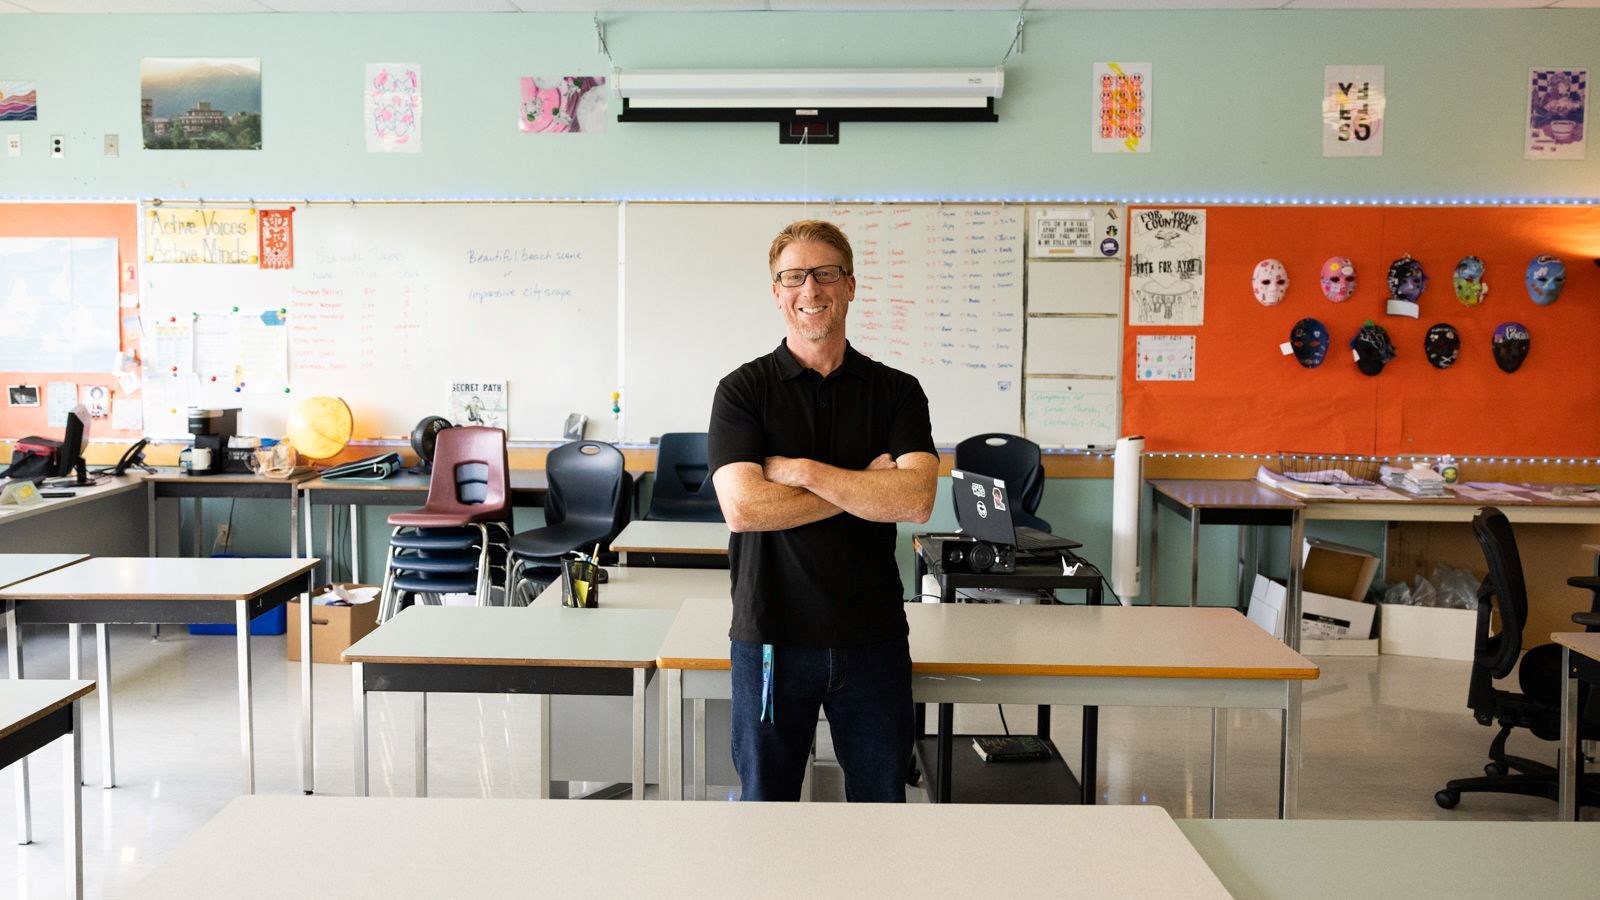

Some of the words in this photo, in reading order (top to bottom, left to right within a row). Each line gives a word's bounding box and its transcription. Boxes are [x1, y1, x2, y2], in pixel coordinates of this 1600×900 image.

[151, 211, 197, 235] Active
[201, 210, 247, 235] Voices
[1140, 210, 1163, 223] FOR
[1172, 210, 1199, 225] YOUR
[1145, 218, 1192, 232] COUNTRY
[152, 238, 198, 262] Active
[202, 238, 249, 263] Minds
[467, 248, 517, 264] Beautiful
[521, 247, 552, 261] beach
[1135, 260, 1153, 274] VOTE
[1158, 260, 1172, 273] FOR
[452, 383, 479, 392] SECRET
[483, 383, 502, 392] PATH
